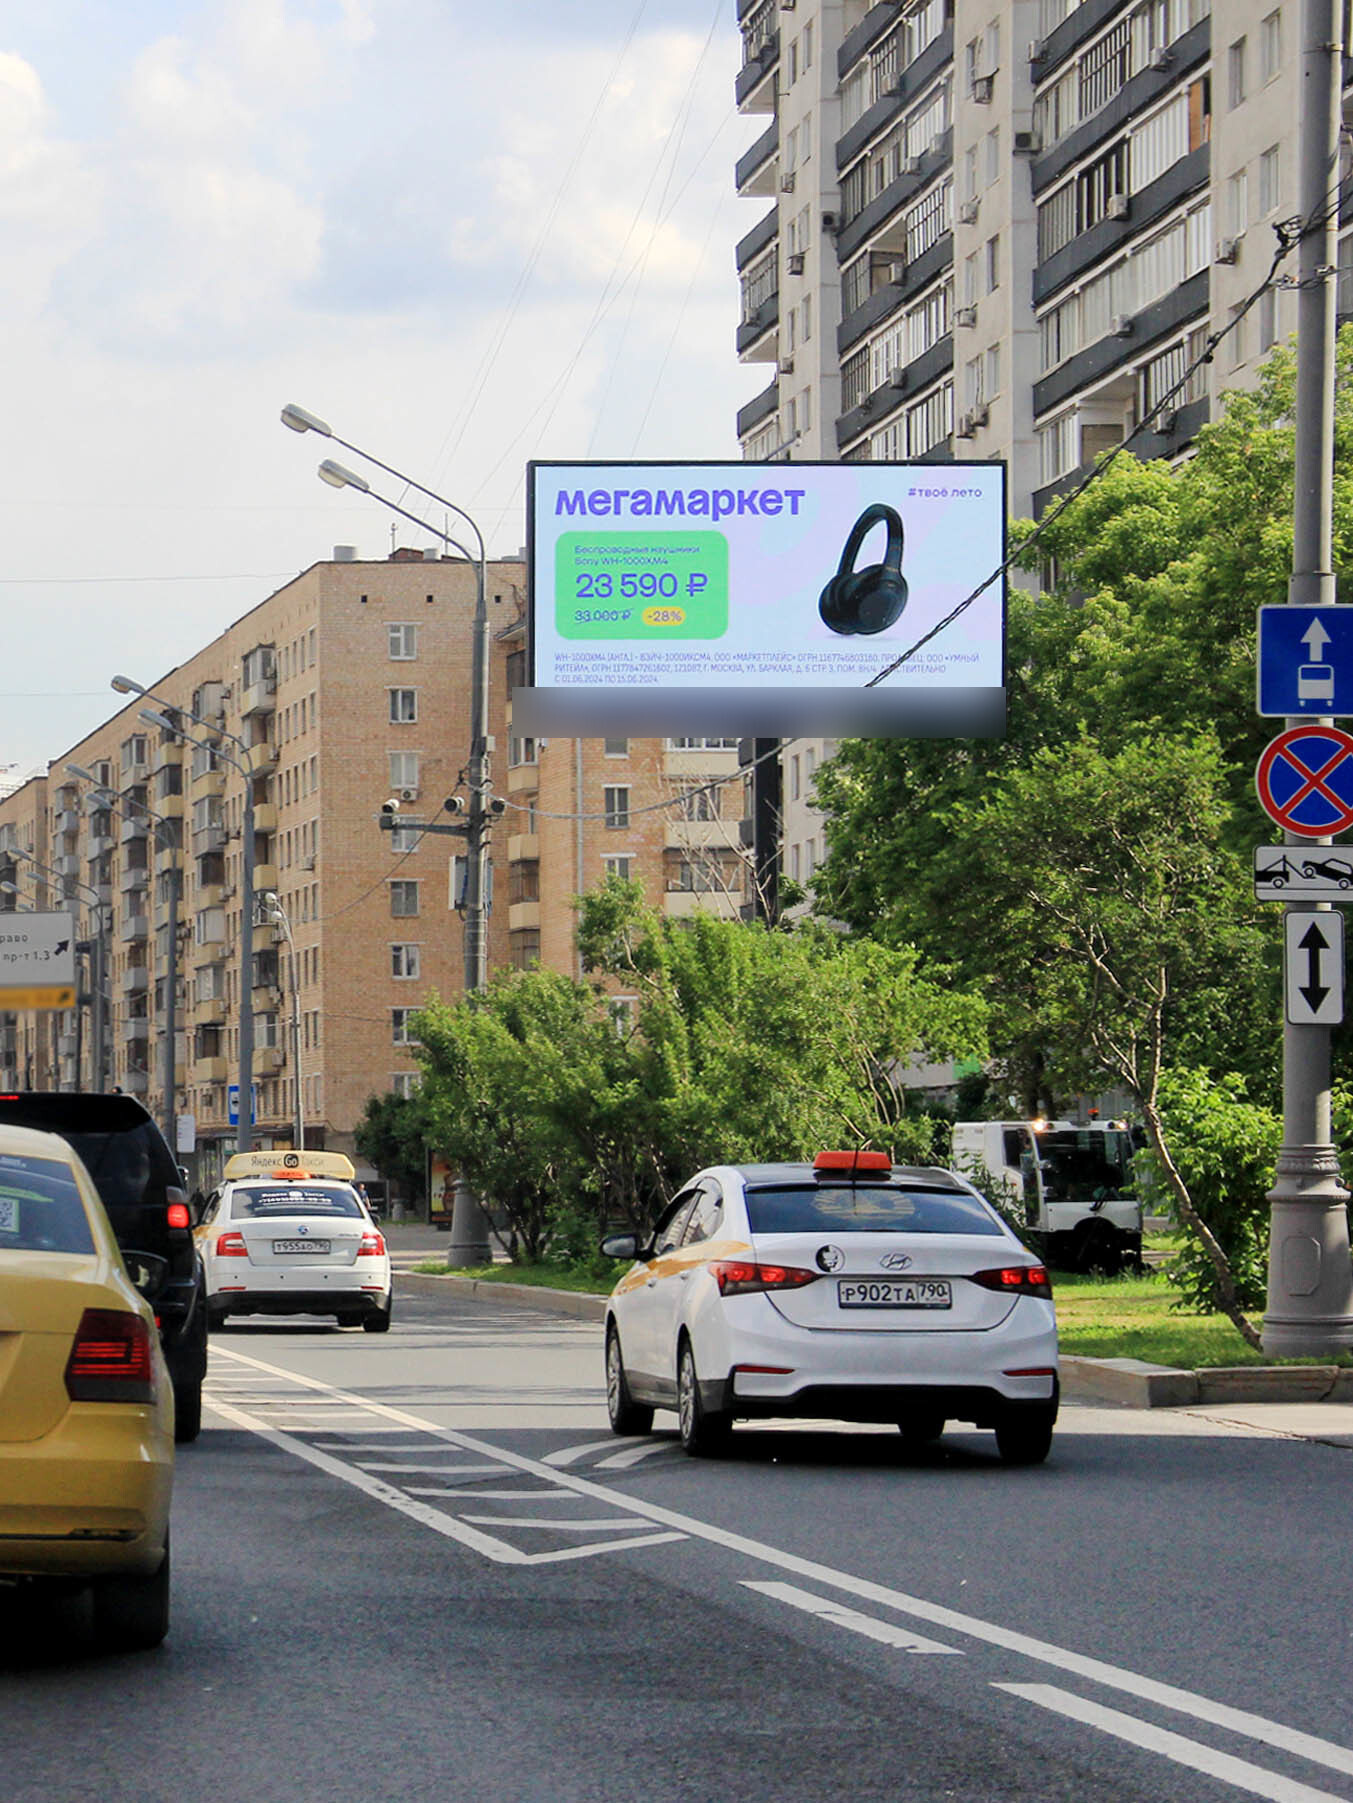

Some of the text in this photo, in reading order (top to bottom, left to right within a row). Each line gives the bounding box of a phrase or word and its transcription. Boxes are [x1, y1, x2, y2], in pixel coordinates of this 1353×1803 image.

[554, 489, 806, 522] мегамаркет
[574, 544, 700, 556] Беспроводные наушники
[574, 556, 669, 566] Sony WH-1000XM4
[575, 572, 614, 598] 23
[619, 572, 679, 598] 590
[647, 609, 683, 622] -28%
[4, 953, 30, 963] пр-т
[284, 1155, 298, 1167] Go
